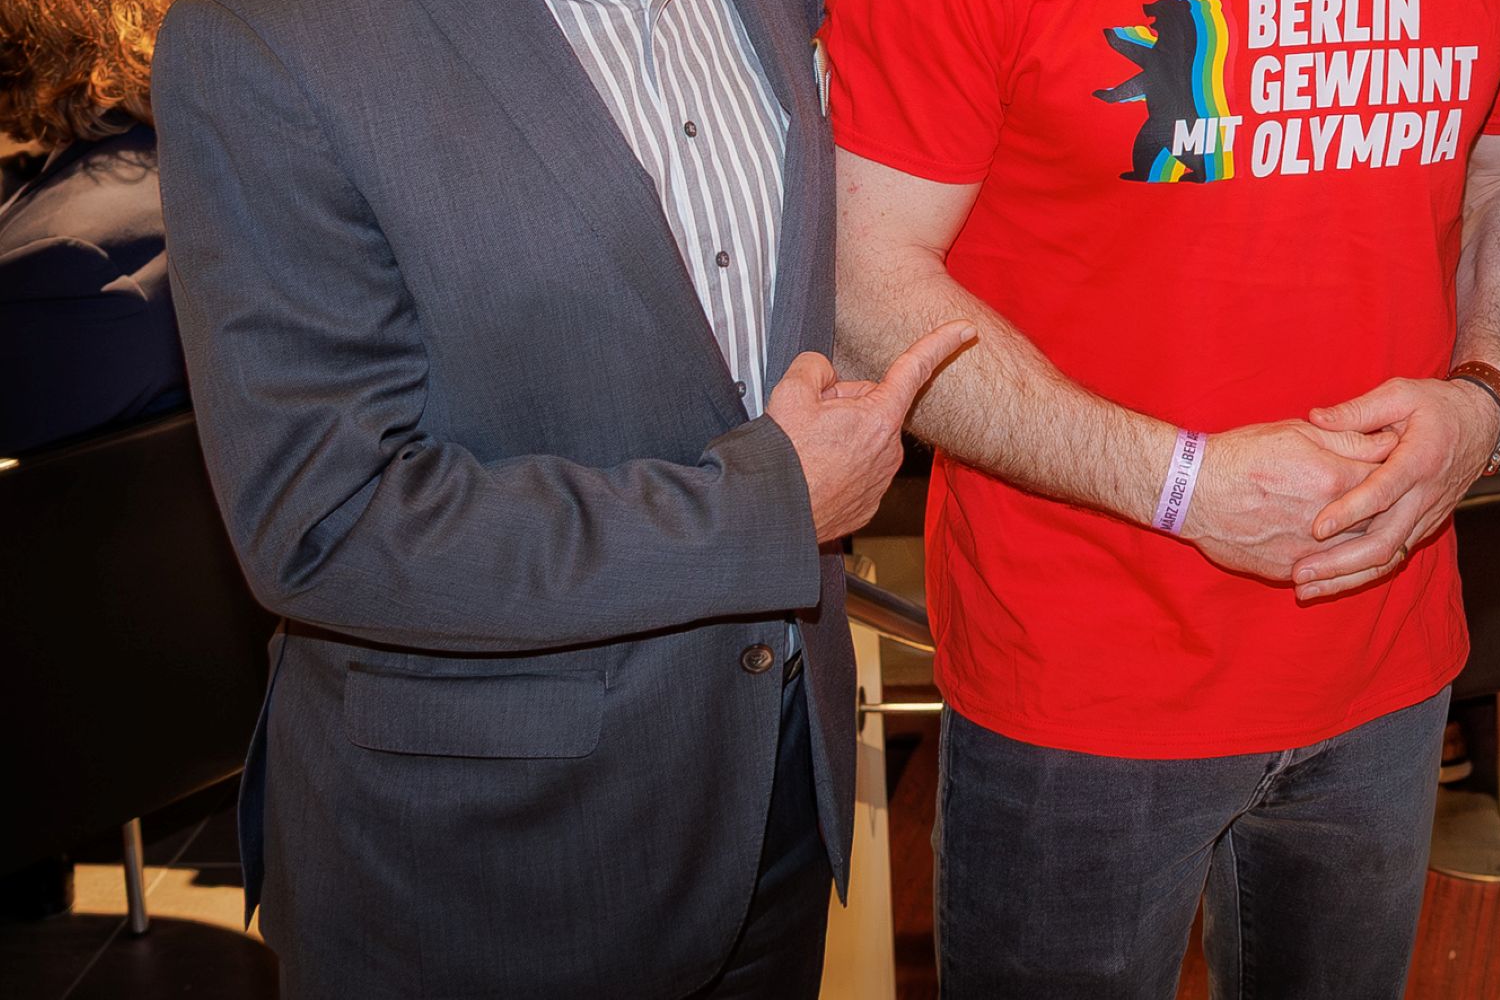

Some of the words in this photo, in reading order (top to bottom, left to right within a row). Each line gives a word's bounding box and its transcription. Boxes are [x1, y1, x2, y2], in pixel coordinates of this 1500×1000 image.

[1250, 46, 1479, 114] GEWINNT
[1172, 116, 1243, 156] MIT
[1251, 108, 1463, 178] OLYMPIA
[1168, 477, 1187, 506] 2026
[1180, 440, 1198, 469] UBER
